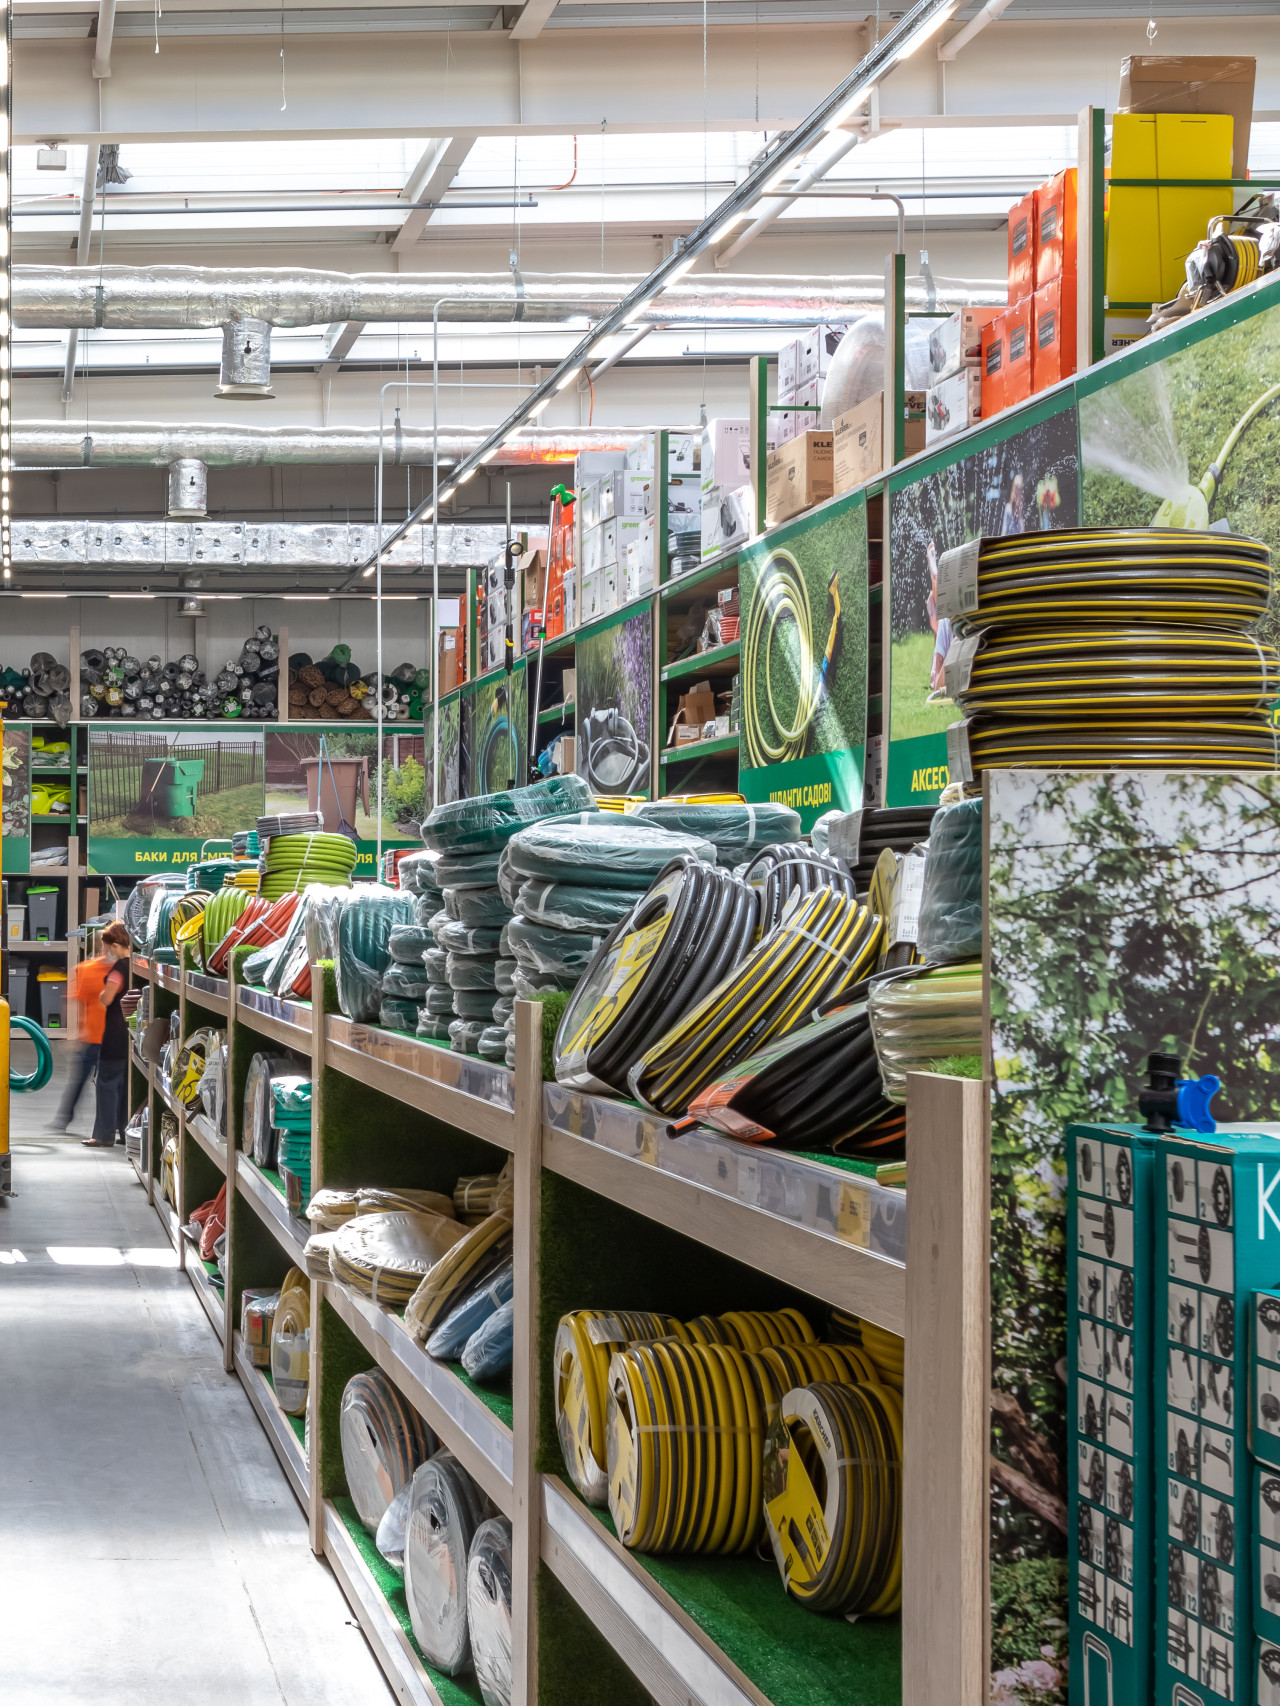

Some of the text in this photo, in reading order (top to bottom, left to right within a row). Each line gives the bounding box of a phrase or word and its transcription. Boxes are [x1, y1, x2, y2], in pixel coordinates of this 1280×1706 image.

[911, 765, 950, 792] АКСЕСУ
[803, 782, 832, 808] САДОВІ
[135, 851, 167, 862] БАКИ
[171, 852, 198, 864] ДЛЯ
[357, 853, 373, 863] ЛЯ
[1106, 1183, 1111, 1196] 2
[1200, 1204, 1206, 1218] 2
[1079, 1235, 1084, 1249] 3
[1170, 1259, 1176, 1273] 3
[1126, 1402, 1131, 1416] 9
[1079, 1416, 1085, 1430] 8
[1079, 1443, 1087, 1460] 10
[1225, 1438, 1231, 1453] 9
[1170, 1452, 1175, 1467] 8
[1169, 1484, 1179, 1499] 10
[1096, 1550, 1103, 1566] 12
[1123, 1567, 1132, 1583] 13
[1187, 1594, 1197, 1611] 12
[1222, 1615, 1233, 1632] 13
